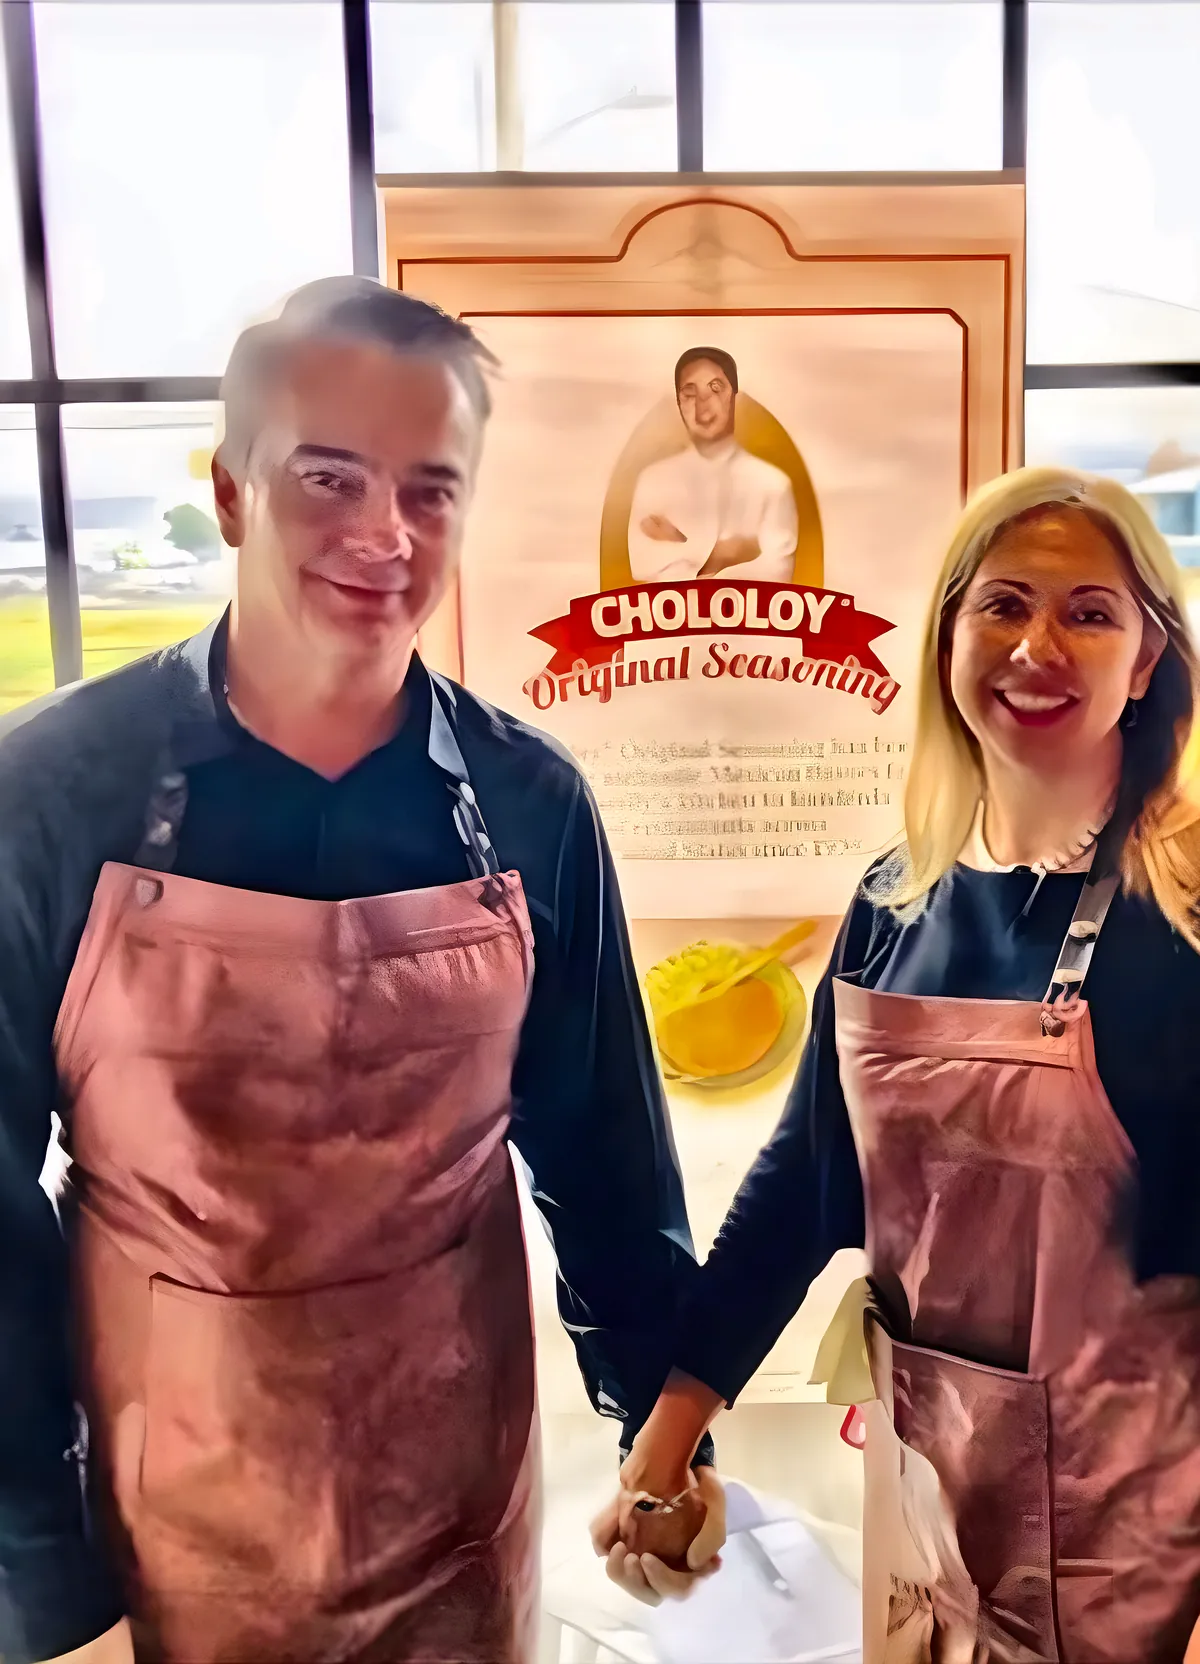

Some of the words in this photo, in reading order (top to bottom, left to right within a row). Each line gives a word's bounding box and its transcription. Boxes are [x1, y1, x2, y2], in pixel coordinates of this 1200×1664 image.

[590, 587, 836, 638] CHOLOLOY
[522, 646, 691, 710] Original
[702, 642, 902, 715] Seasoning
